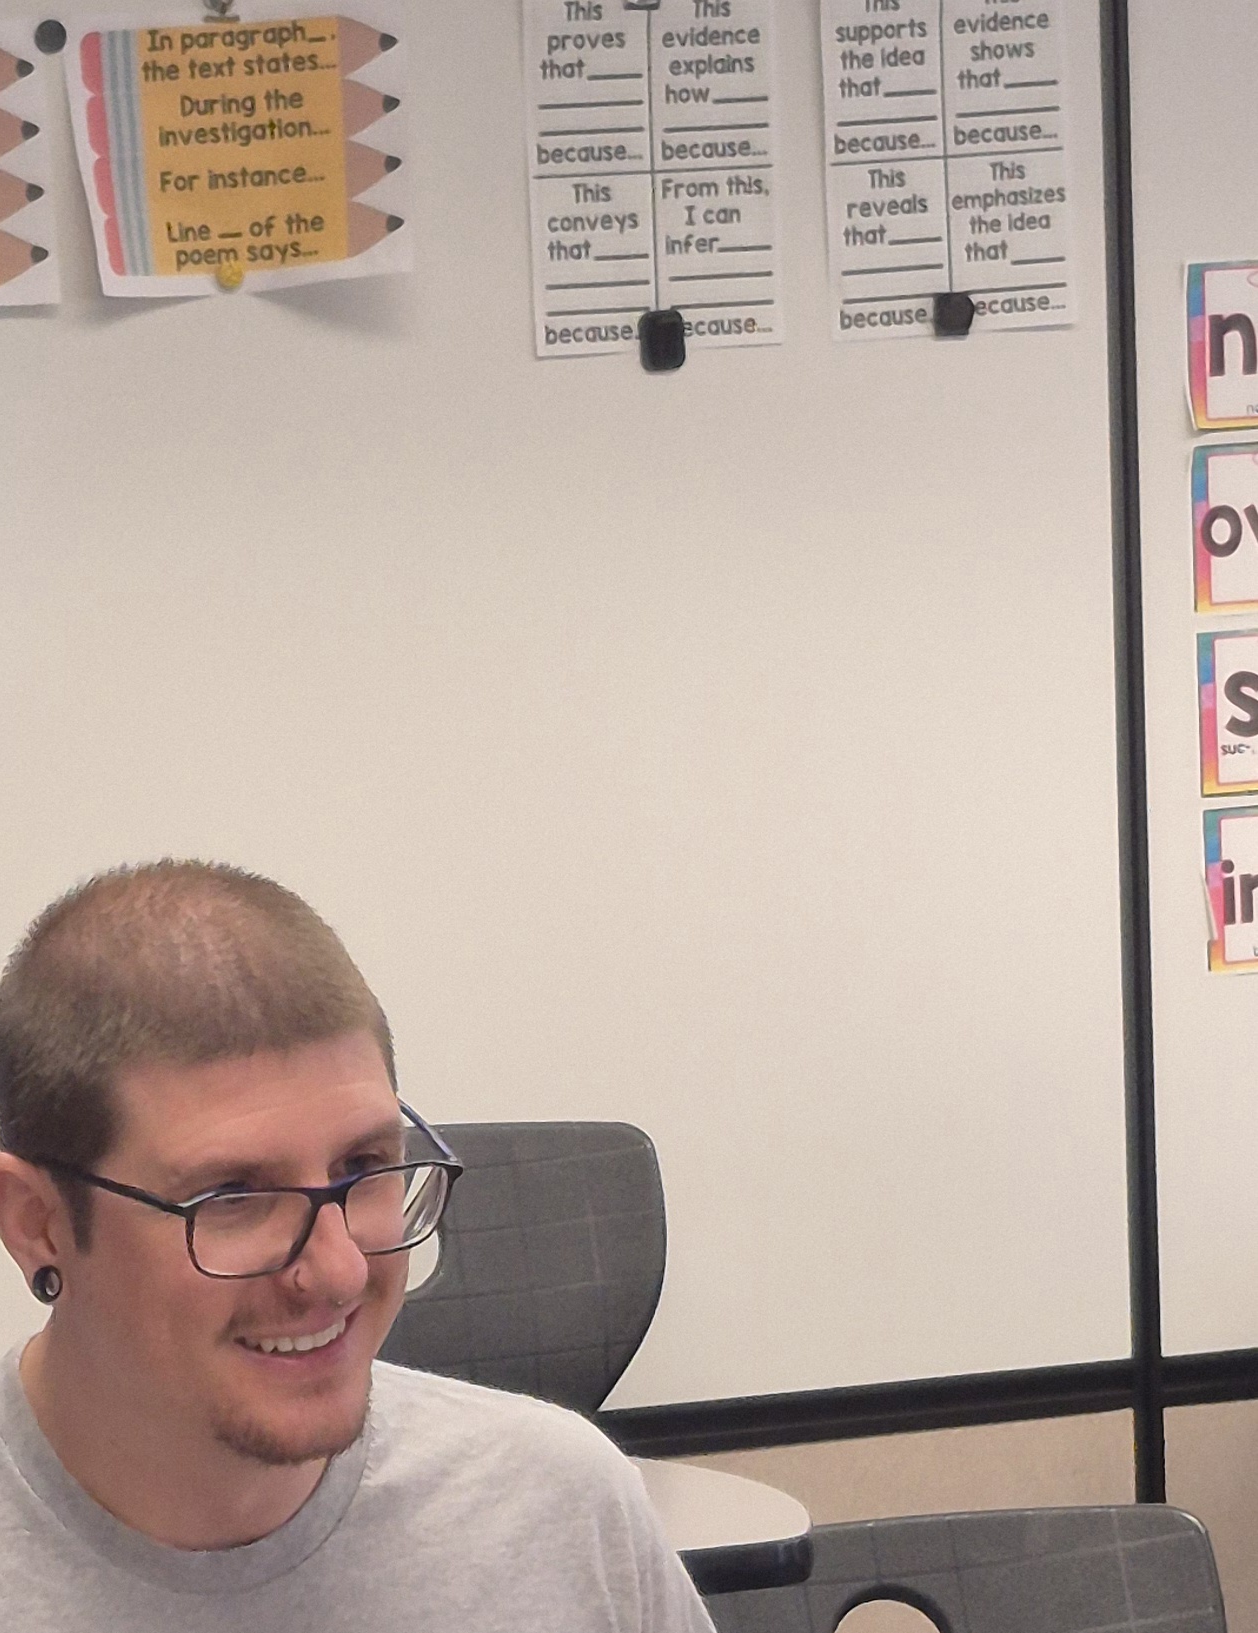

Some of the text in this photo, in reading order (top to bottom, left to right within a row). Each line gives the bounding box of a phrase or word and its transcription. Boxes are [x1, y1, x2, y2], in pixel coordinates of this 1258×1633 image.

[564, 1, 603, 22] This
[693, 0, 731, 18] This
[835, 19, 927, 46] supports
[953, 12, 1050, 34] evidence
[147, 29, 173, 52] In
[547, 31, 626, 55] proves
[661, 26, 761, 48] evidence
[840, 48, 925, 70] the idea
[970, 41, 1035, 62] shows
[142, 61, 180, 83] the
[189, 57, 235, 80] text
[539, 58, 586, 80] that
[668, 54, 755, 79] explains
[839, 77, 882, 98] that
[957, 68, 1001, 90] that
[180, 89, 304, 118] During the
[664, 84, 710, 105] how
[159, 171, 200, 193] For
[868, 169, 906, 189] This
[989, 161, 1025, 181] This
[572, 183, 612, 204] This
[661, 178, 719, 199] From
[951, 185, 1066, 211] emphasizes
[684, 205, 741, 226] I can
[846, 194, 928, 219] reveals
[166, 212, 325, 244] Line of the
[547, 212, 639, 234] conveys
[969, 212, 1051, 235] the idea
[664, 234, 720, 255] infer
[843, 225, 886, 246] that
[175, 247, 239, 272] poem
[547, 239, 592, 262] that
[964, 241, 1008, 263] that
[974, 293, 1066, 317] ecause...
[683, 317, 773, 338] ecause...
